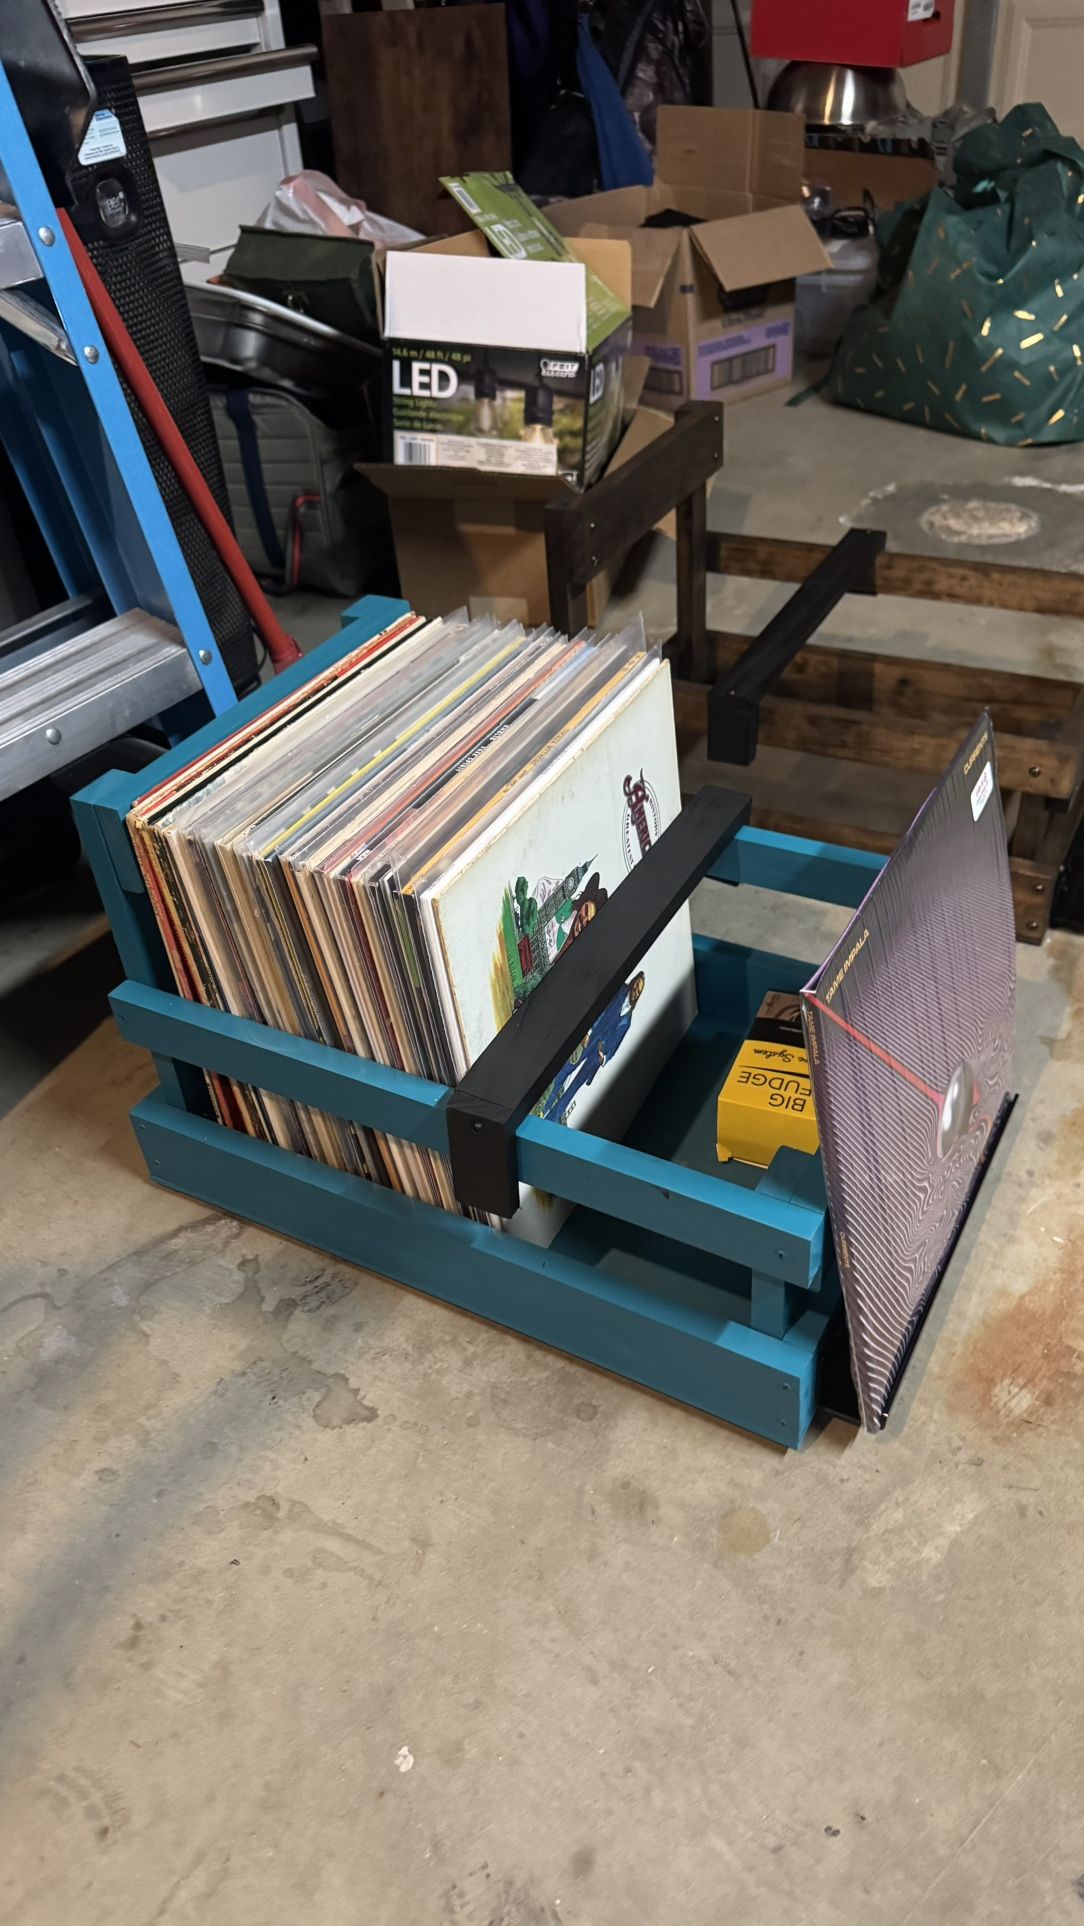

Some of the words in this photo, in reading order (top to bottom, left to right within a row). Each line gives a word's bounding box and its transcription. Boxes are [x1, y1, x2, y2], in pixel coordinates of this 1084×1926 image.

[424, 350, 436, 360] 48
[451, 352, 462, 362] 48
[392, 359, 459, 399] LED
[589, 362, 605, 405] LED
[825, 967, 844, 1005] TAME
[843, 928, 870, 974] IMPALA
[752, 1047, 795, 1064] System
[737, 1070, 812, 1097] FUDGE
[768, 1093, 807, 1113] BIG
